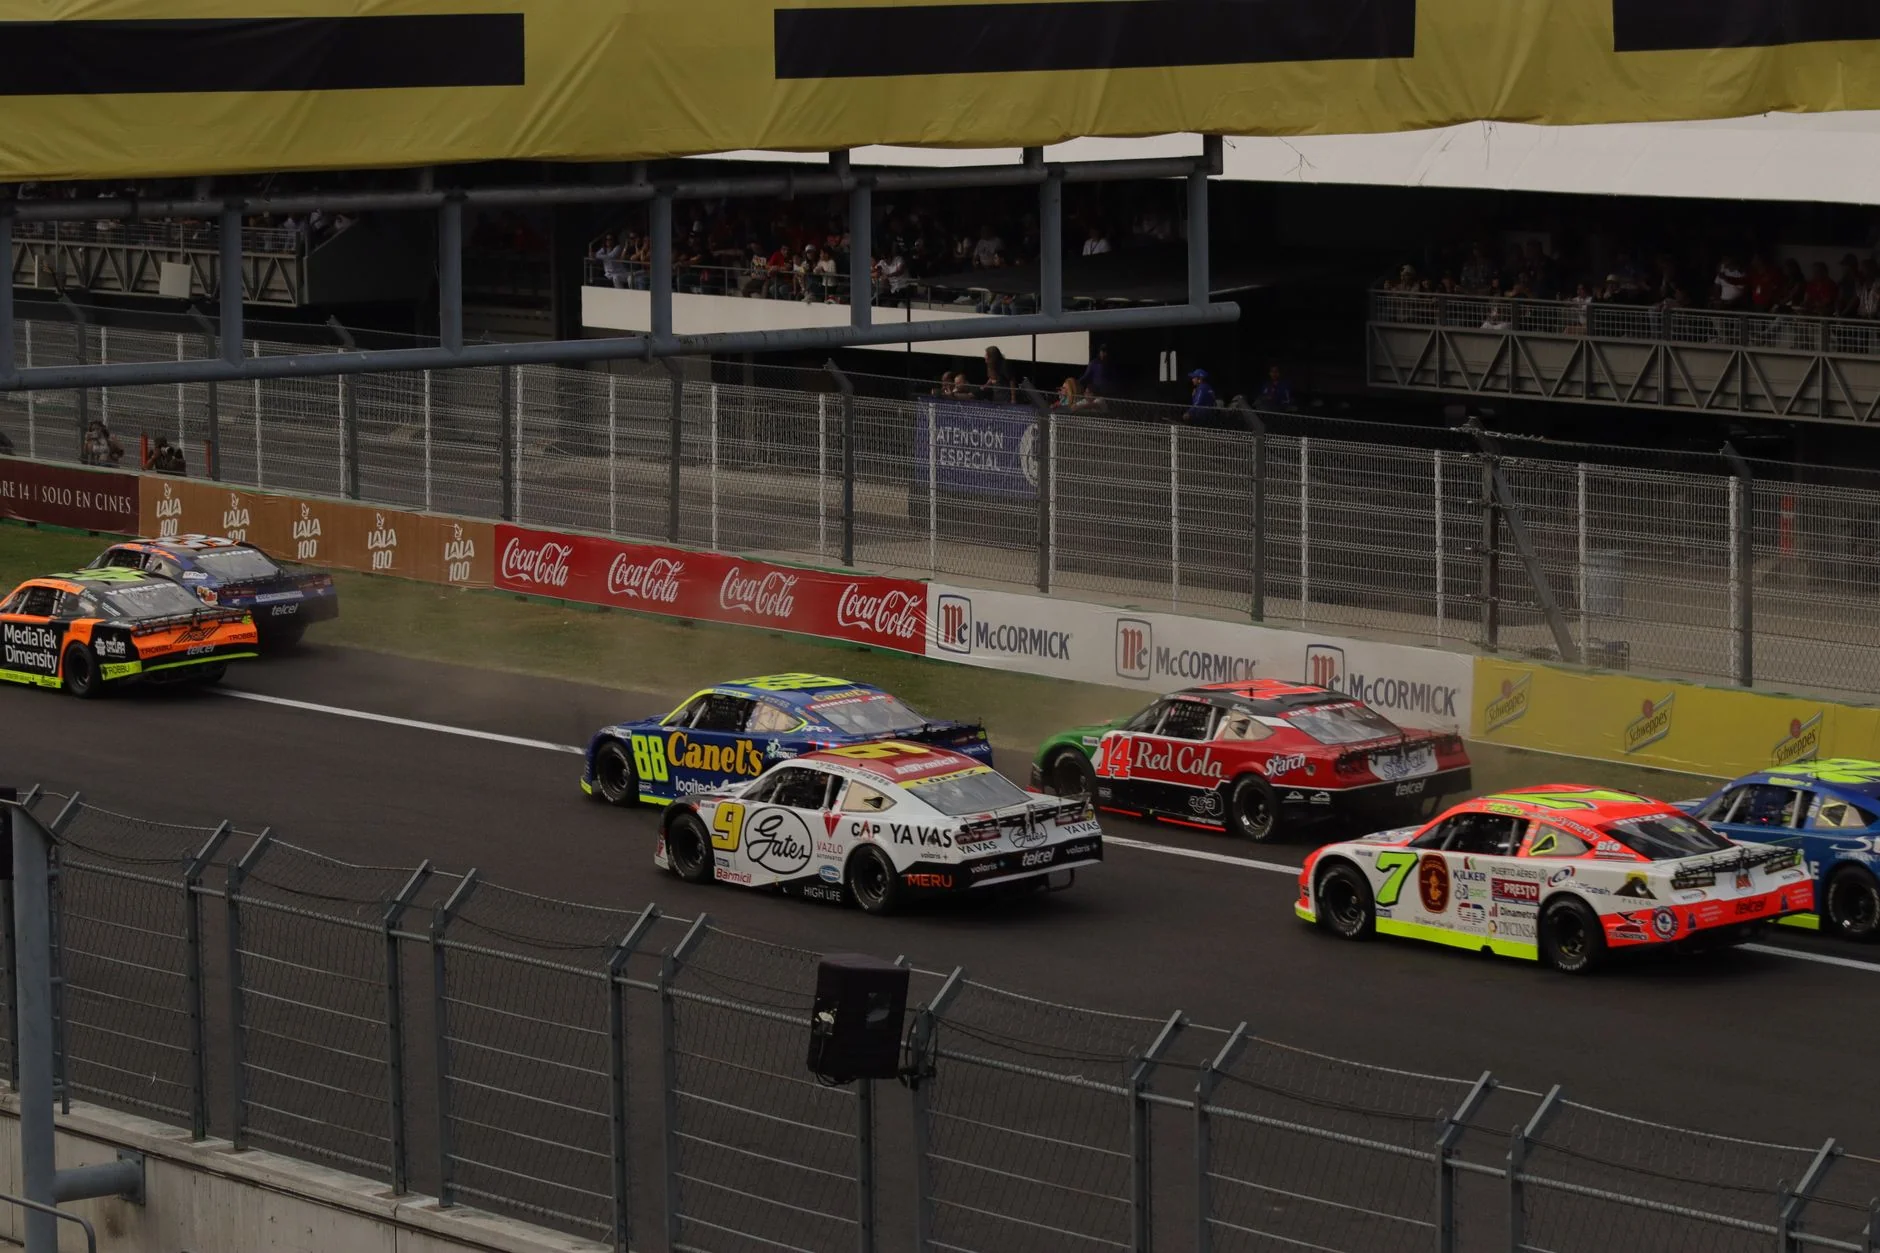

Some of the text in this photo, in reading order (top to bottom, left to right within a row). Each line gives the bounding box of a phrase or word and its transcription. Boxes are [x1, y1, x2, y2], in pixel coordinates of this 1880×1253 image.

[940, 448, 1000, 471] ESPECIAL
[19, 482, 30, 501] 14
[42, 486, 71, 506] SOLO
[76, 490, 91, 508] EN
[95, 494, 132, 515] CINES
[157, 498, 182, 518] LALA
[161, 518, 178, 537] 100
[223, 508, 250, 529] LALA
[293, 518, 321, 540] LALA
[297, 539, 317, 560] 100
[368, 527, 397, 551] LALA
[445, 539, 475, 561] LALA
[372, 549, 393, 571] 100
[449, 560, 470, 582] 100
[502, 537, 573, 587] Coca-Cola
[608, 553, 684, 604] Coca-Cola
[720, 567, 799, 618] Coca-Cola
[272, 602, 299, 617] telcel
[838, 583, 922, 639] Coca-Cola
[4, 623, 57, 650] MediaTek
[976, 623, 1071, 660] McCORMICK
[5, 644, 58, 675] Dimensity
[186, 644, 215, 656] telcel
[1156, 646, 1254, 685] McCORMICK
[1350, 673, 1457, 718] McCORMICK
[1488, 690, 1526, 724] Schweppes
[1629, 708, 1668, 745] Schweppes
[631, 735, 670, 782] 88
[666, 731, 765, 778] Canel's
[1096, 735, 1133, 780] 14
[1775, 727, 1817, 768] Schweppes
[1134, 741, 1225, 779] Red Cola
[1264, 752, 1306, 778] Starch
[674, 775, 720, 797] logitech
[1395, 779, 1427, 797] telcel
[711, 801, 746, 852] 9
[851, 820, 881, 840] CAP
[748, 815, 812, 863] Gates
[817, 841, 843, 855] VAZLO
[1065, 843, 1091, 856] volaris
[920, 851, 943, 862] volaris
[1021, 848, 1055, 868] telcel
[715, 868, 753, 885] Barmicil
[970, 861, 998, 876] volaris
[1376, 850, 1419, 907] 7
[906, 873, 954, 889] MERU
[1503, 882, 1538, 899] PRESTO
[803, 885, 841, 903] HIGH LIFE
